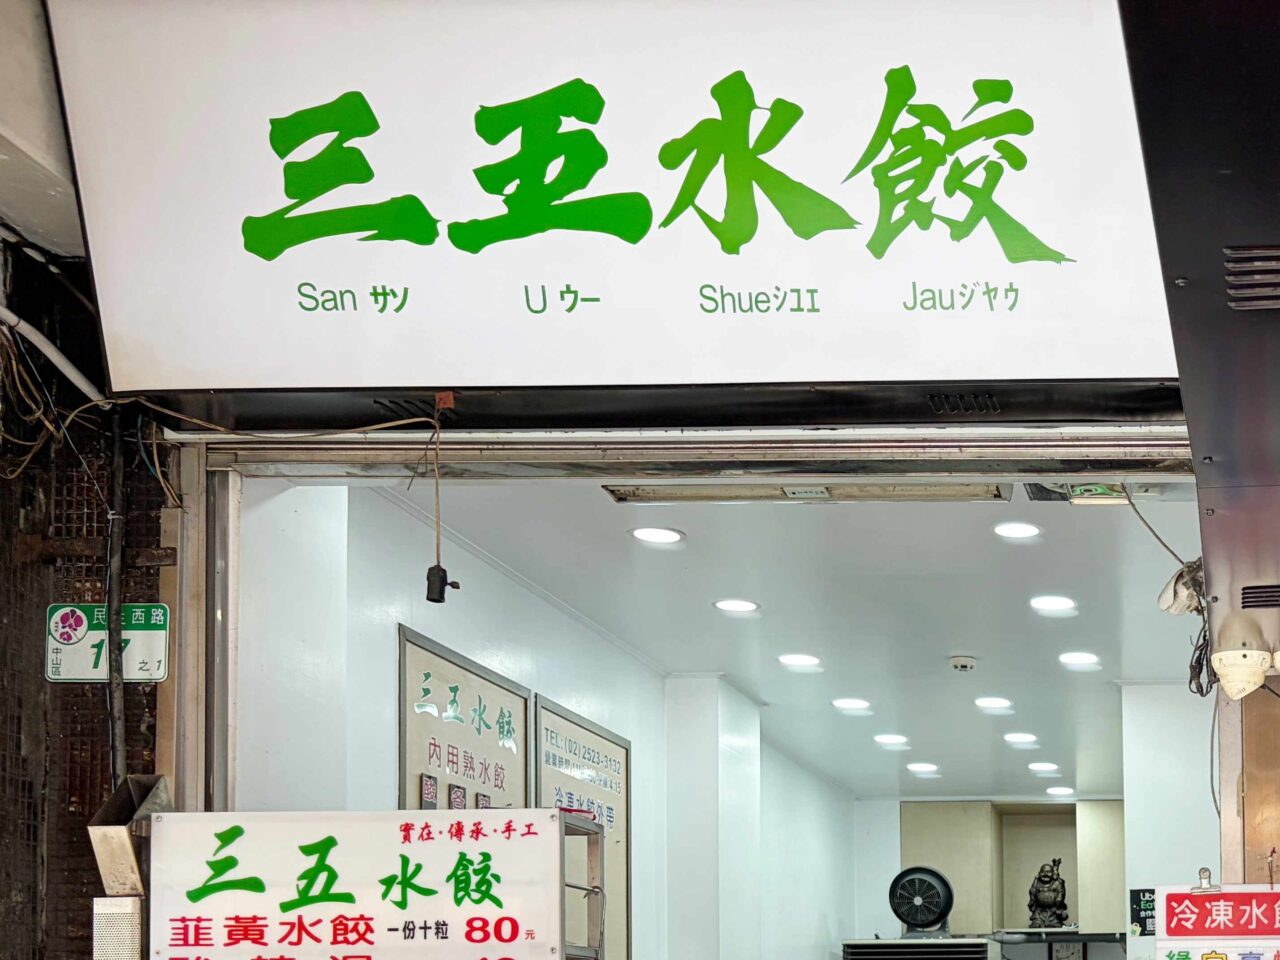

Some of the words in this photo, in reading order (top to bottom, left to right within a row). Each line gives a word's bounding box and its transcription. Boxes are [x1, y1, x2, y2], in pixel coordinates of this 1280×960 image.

[241, 65, 1077, 261] 三五水餃
[297, 282, 358, 312] San
[524, 284, 548, 314] U
[559, 284, 601, 313] ウー
[414, 671, 518, 756] 三五水餃
[428, 736, 507, 793] 內用熟水餃
[185, 825, 503, 912] 三五水餃
[168, 914, 375, 947] 韮黃水餃
[387, 919, 449, 940] 一份十粒
[464, 917, 519, 943] 80
[525, 929, 535, 940] 元
